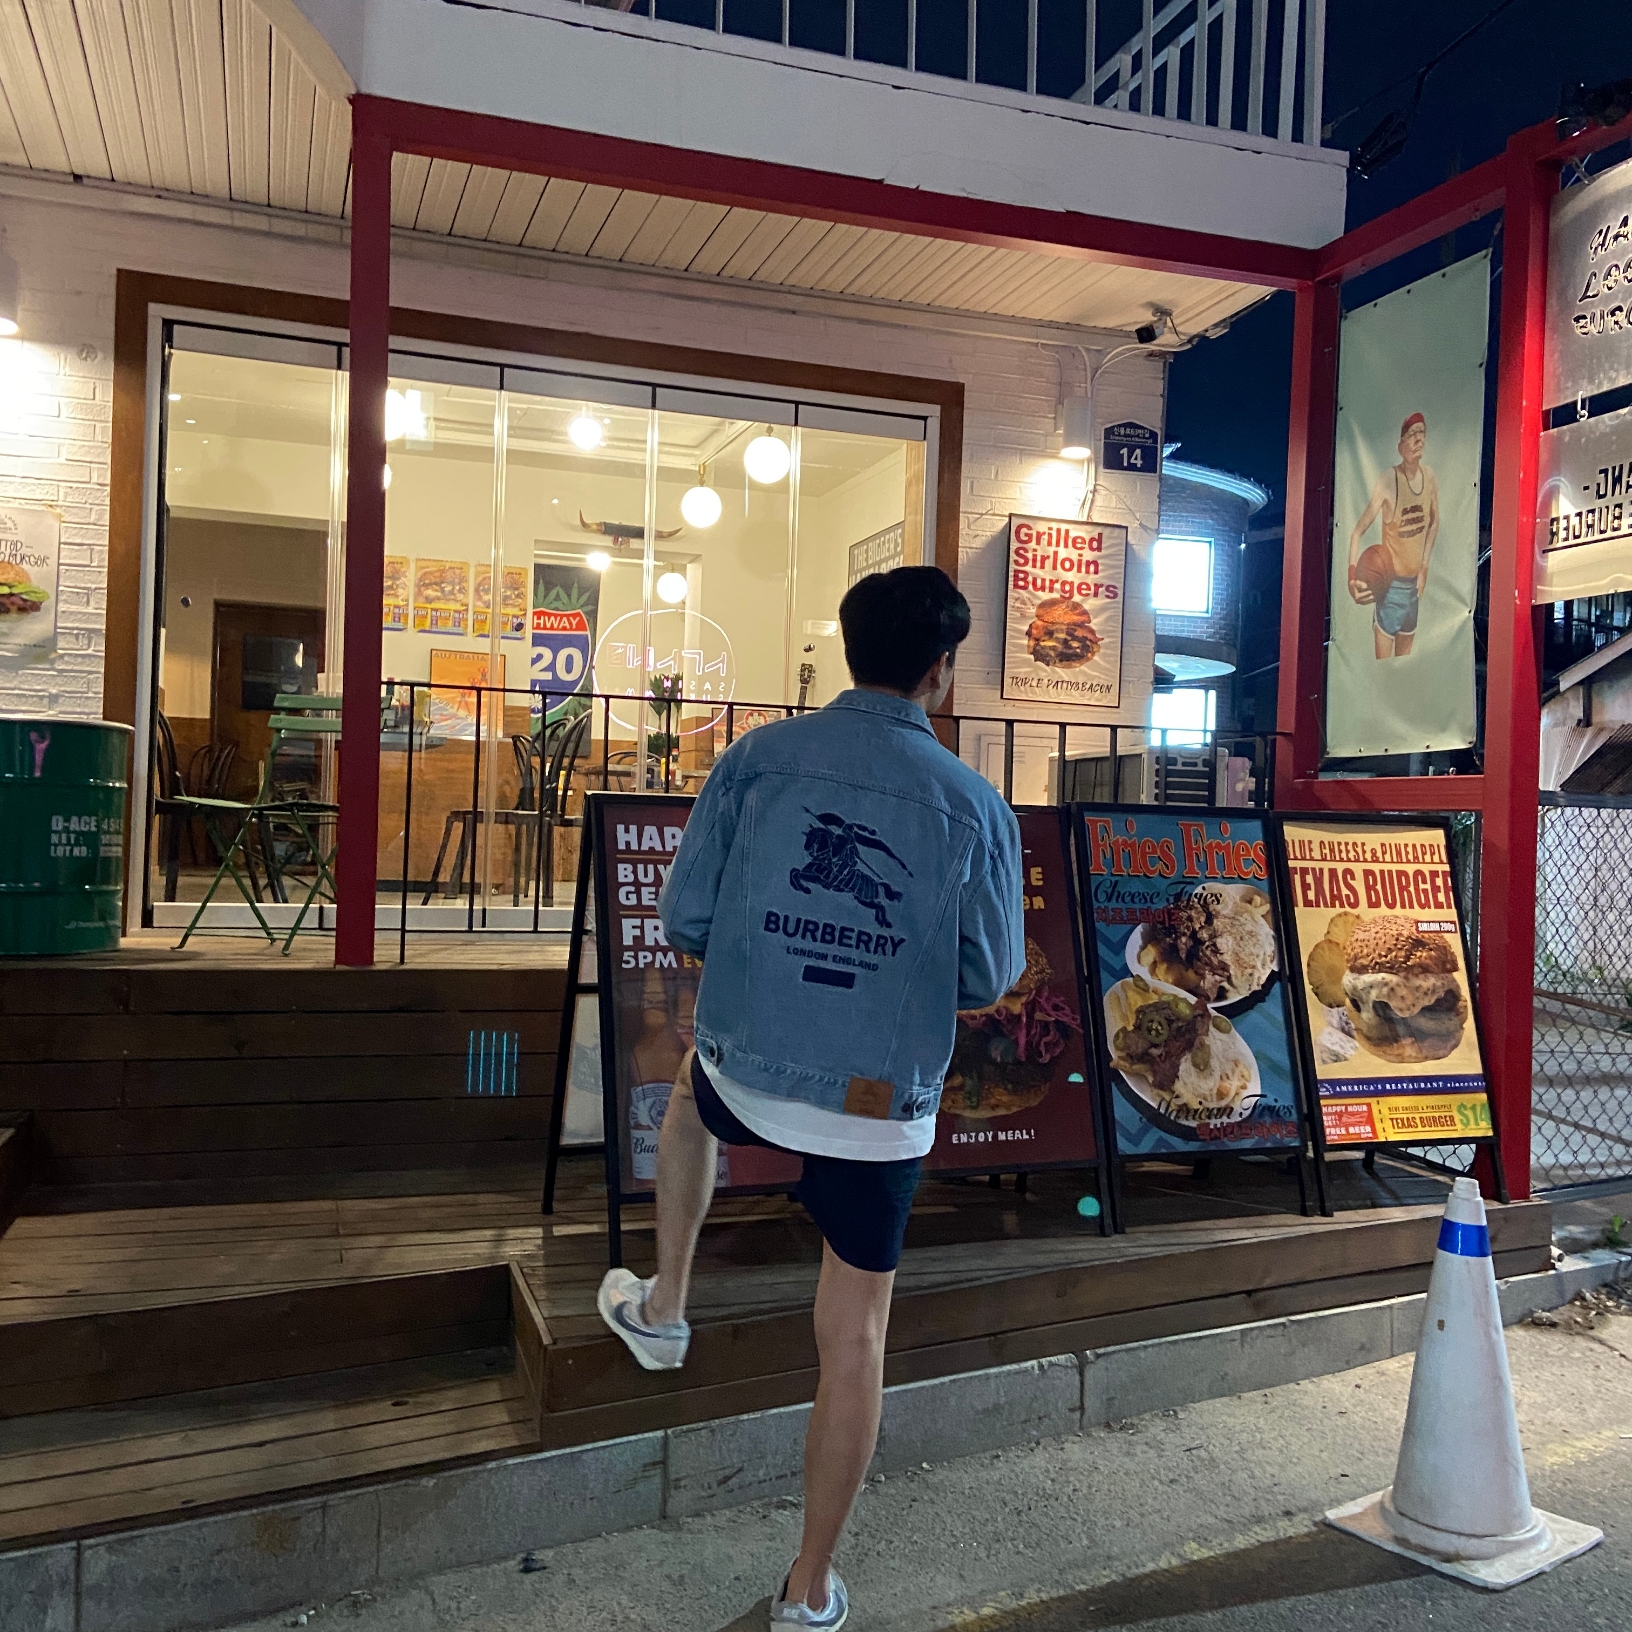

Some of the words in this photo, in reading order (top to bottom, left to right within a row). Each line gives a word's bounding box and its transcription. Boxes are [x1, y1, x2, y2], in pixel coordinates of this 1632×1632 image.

[1119, 447, 1143, 468] 14
[853, 544, 868, 571] THE
[867, 528, 902, 565] BIGGER'S
[1014, 523, 1103, 553] Grilled
[1013, 546, 1100, 575] Sirloin
[1012, 569, 1119, 600] Burgers
[533, 615, 580, 629] HWAY
[433, 652, 487, 661] AUSTRALIA
[530, 646, 584, 682] 20
[1010, 676, 1044, 689] TRIPLE
[616, 824, 684, 851] HAP
[1084, 816, 1178, 878] Fries
[1178, 820, 1270, 880] Fries
[618, 885, 662, 906] GE
[1093, 879, 1161, 905] Cheese
[1165, 881, 1223, 906] Fries
[1289, 867, 1360, 909] TEXAS
[763, 910, 907, 958] BURBERRY
[621, 951, 678, 969] 5PM
[786, 945, 829, 962] LONDON
[832, 954, 879, 972] ENGLAND
[1335, 1083, 1382, 1092] AMERICA'S
[1385, 1081, 1443, 1090] RESTAURANT
[1239, 1093, 1294, 1119] Fries
[1322, 1105, 1346, 1113] HAPPY
[1347, 1104, 1368, 1112] HOUR
[1326, 1127, 1347, 1135] FREE
[1348, 1125, 1372, 1134] BEER
[1389, 1116, 1419, 1130] TEXAS
[1419, 1115, 1457, 1129] BURGER
[951, 1130, 994, 1144] ENJOY
[997, 1128, 1036, 1141] MEAL!
